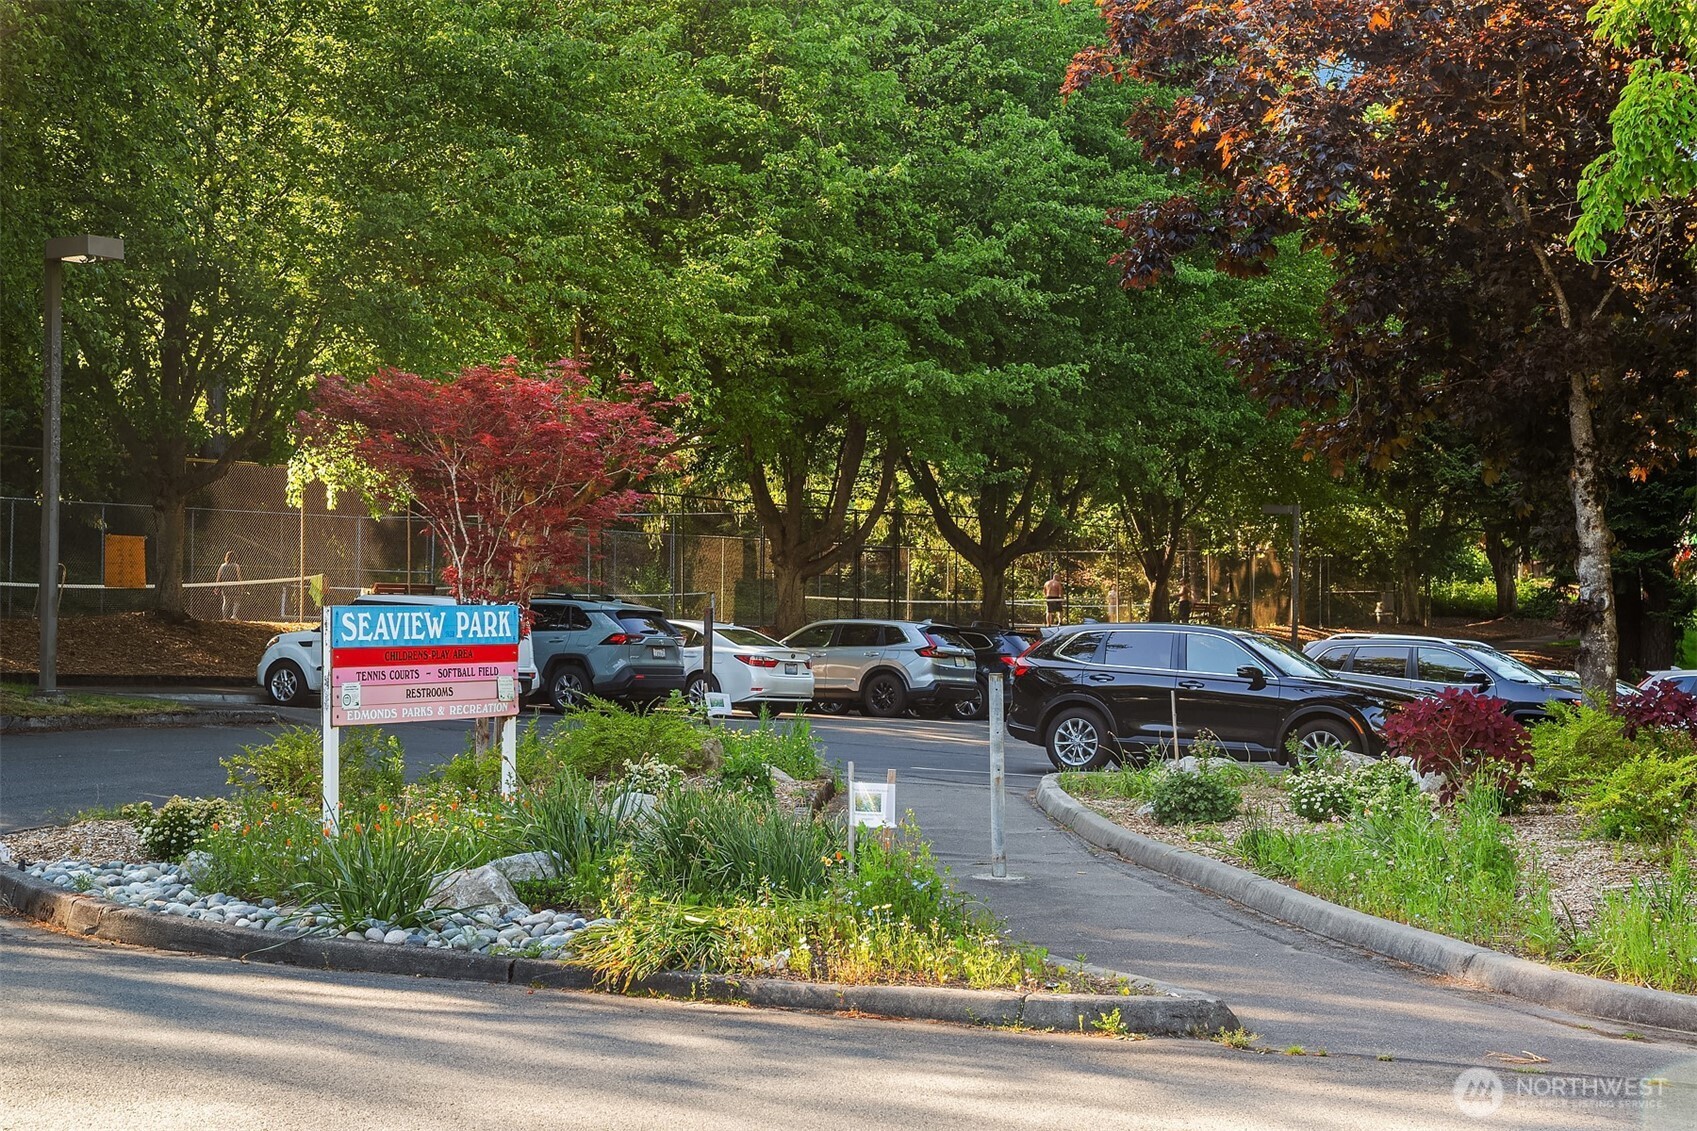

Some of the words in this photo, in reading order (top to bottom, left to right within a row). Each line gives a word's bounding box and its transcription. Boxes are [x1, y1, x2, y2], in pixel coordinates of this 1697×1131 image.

[341, 611, 446, 642] SEAVIEW
[455, 611, 512, 638] PARK
[431, 649, 449, 660] PLAY
[453, 648, 473, 659] AREA
[356, 670, 386, 682] TENNIS
[389, 669, 420, 680] COURTS
[437, 667, 475, 678] SOFTBALL
[478, 666, 499, 677] FIELD
[406, 687, 454, 699] RESTROOMS
[347, 708, 398, 721] EDMONDS
[402, 706, 433, 718] PARKS
[437, 705, 445, 716] &
[449, 702, 509, 715] RECREATION
